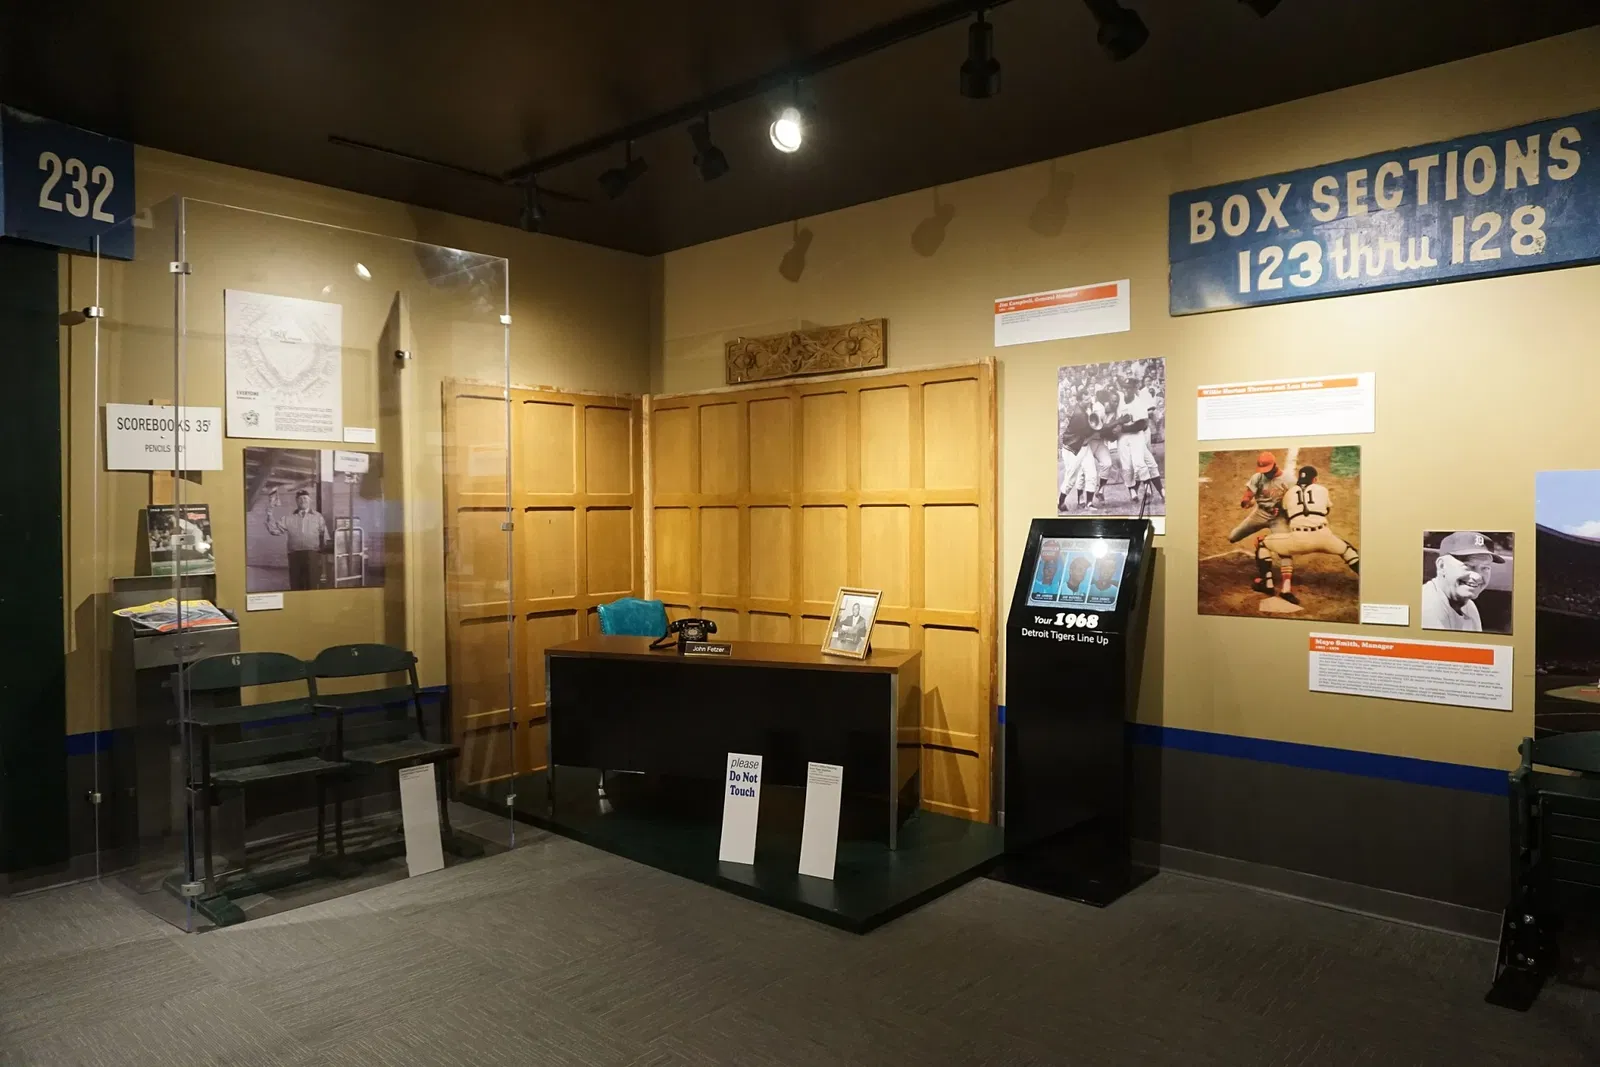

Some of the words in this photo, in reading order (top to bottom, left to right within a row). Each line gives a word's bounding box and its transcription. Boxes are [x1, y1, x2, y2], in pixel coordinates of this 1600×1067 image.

[38, 151, 115, 224] 232
[1190, 183, 1292, 244] BOX
[1311, 127, 1582, 223] SECTIONS
[1239, 240, 1323, 293] 123
[1328, 233, 1438, 280] thru
[1451, 205, 1548, 265] 128
[117, 417, 191, 433] SCOREBOOKS
[145, 444, 171, 453] PENCILS
[1296, 489, 1315, 506] 11
[1474, 534, 1485, 546] D
[1034, 615, 1053, 625] Your
[1054, 612, 1100, 629] 1968
[1021, 627, 1049, 639] Detroit
[1051, 630, 1076, 642] Tigers
[1077, 633, 1095, 644] Line
[1096, 635, 1109, 646] Up
[707, 645, 725, 653] Fetzer
[1335, 640, 1361, 648] Smith,
[1361, 642, 1395, 651] Manager
[231, 656, 241, 666] 6
[731, 758, 760, 769] please
[729, 770, 741, 782] Do
[742, 772, 758, 783] Not
[730, 785, 755, 798] Touch
